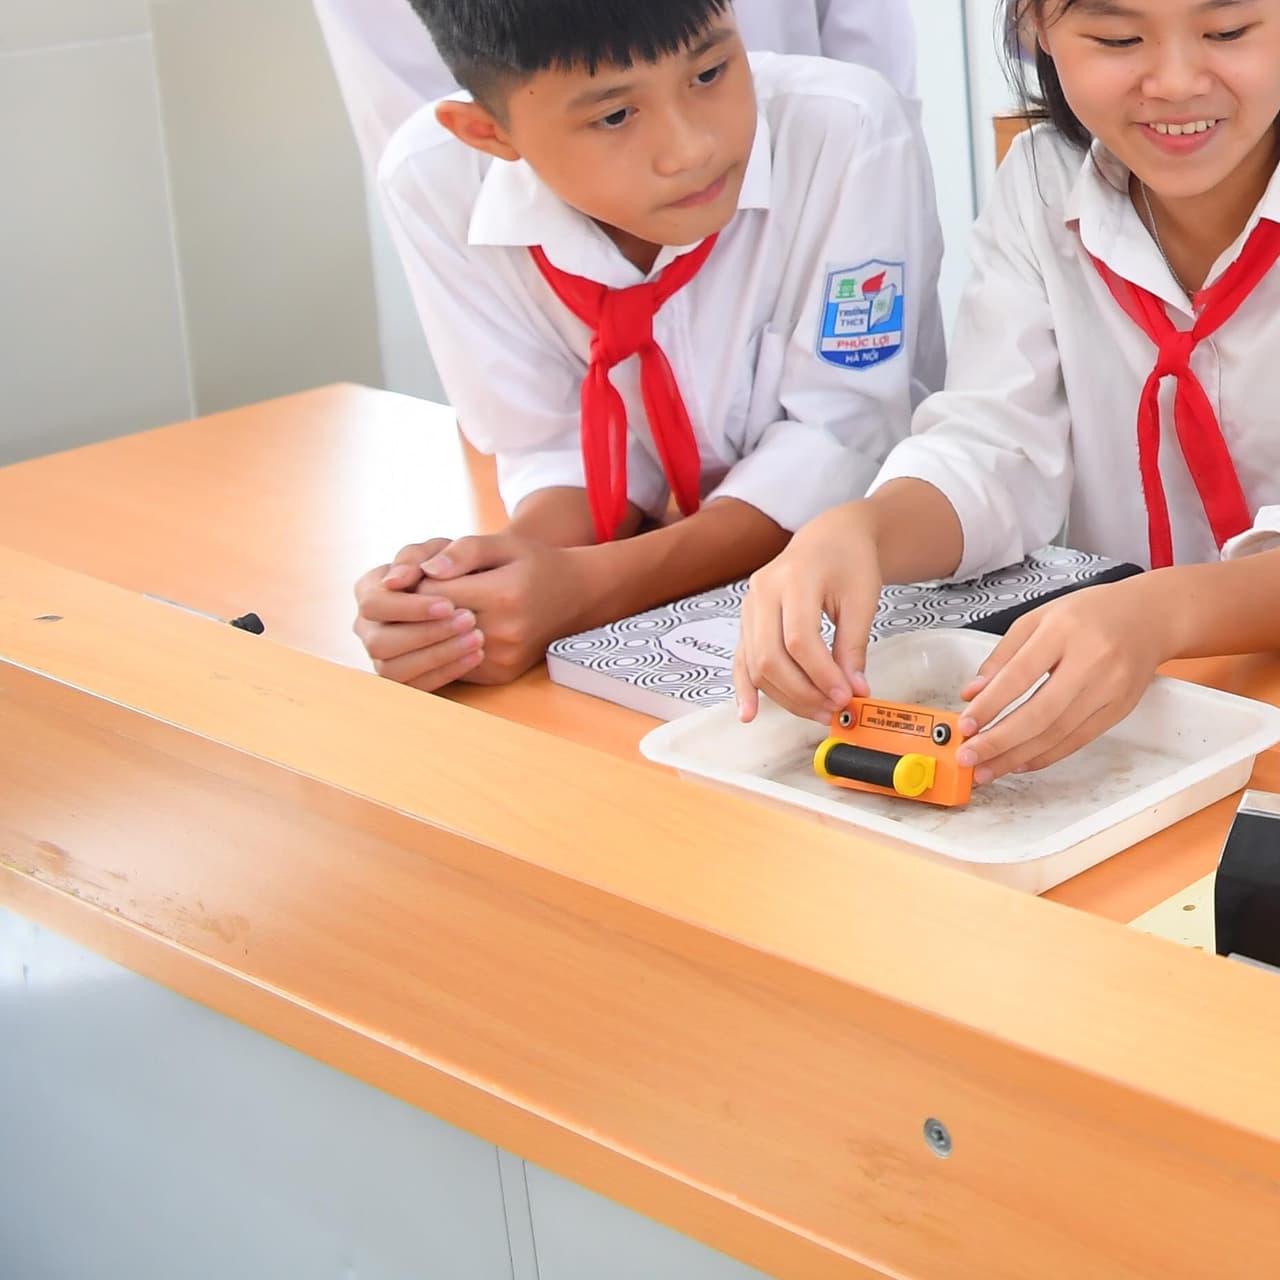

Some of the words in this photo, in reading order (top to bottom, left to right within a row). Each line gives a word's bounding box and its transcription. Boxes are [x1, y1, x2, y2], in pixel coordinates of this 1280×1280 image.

[841, 318, 865, 327] THCS
[836, 336, 869, 349] PHÚC
[872, 335, 890, 348] LỢI
[845, 352, 860, 363] HÀ
[861, 350, 879, 362] NỘI
